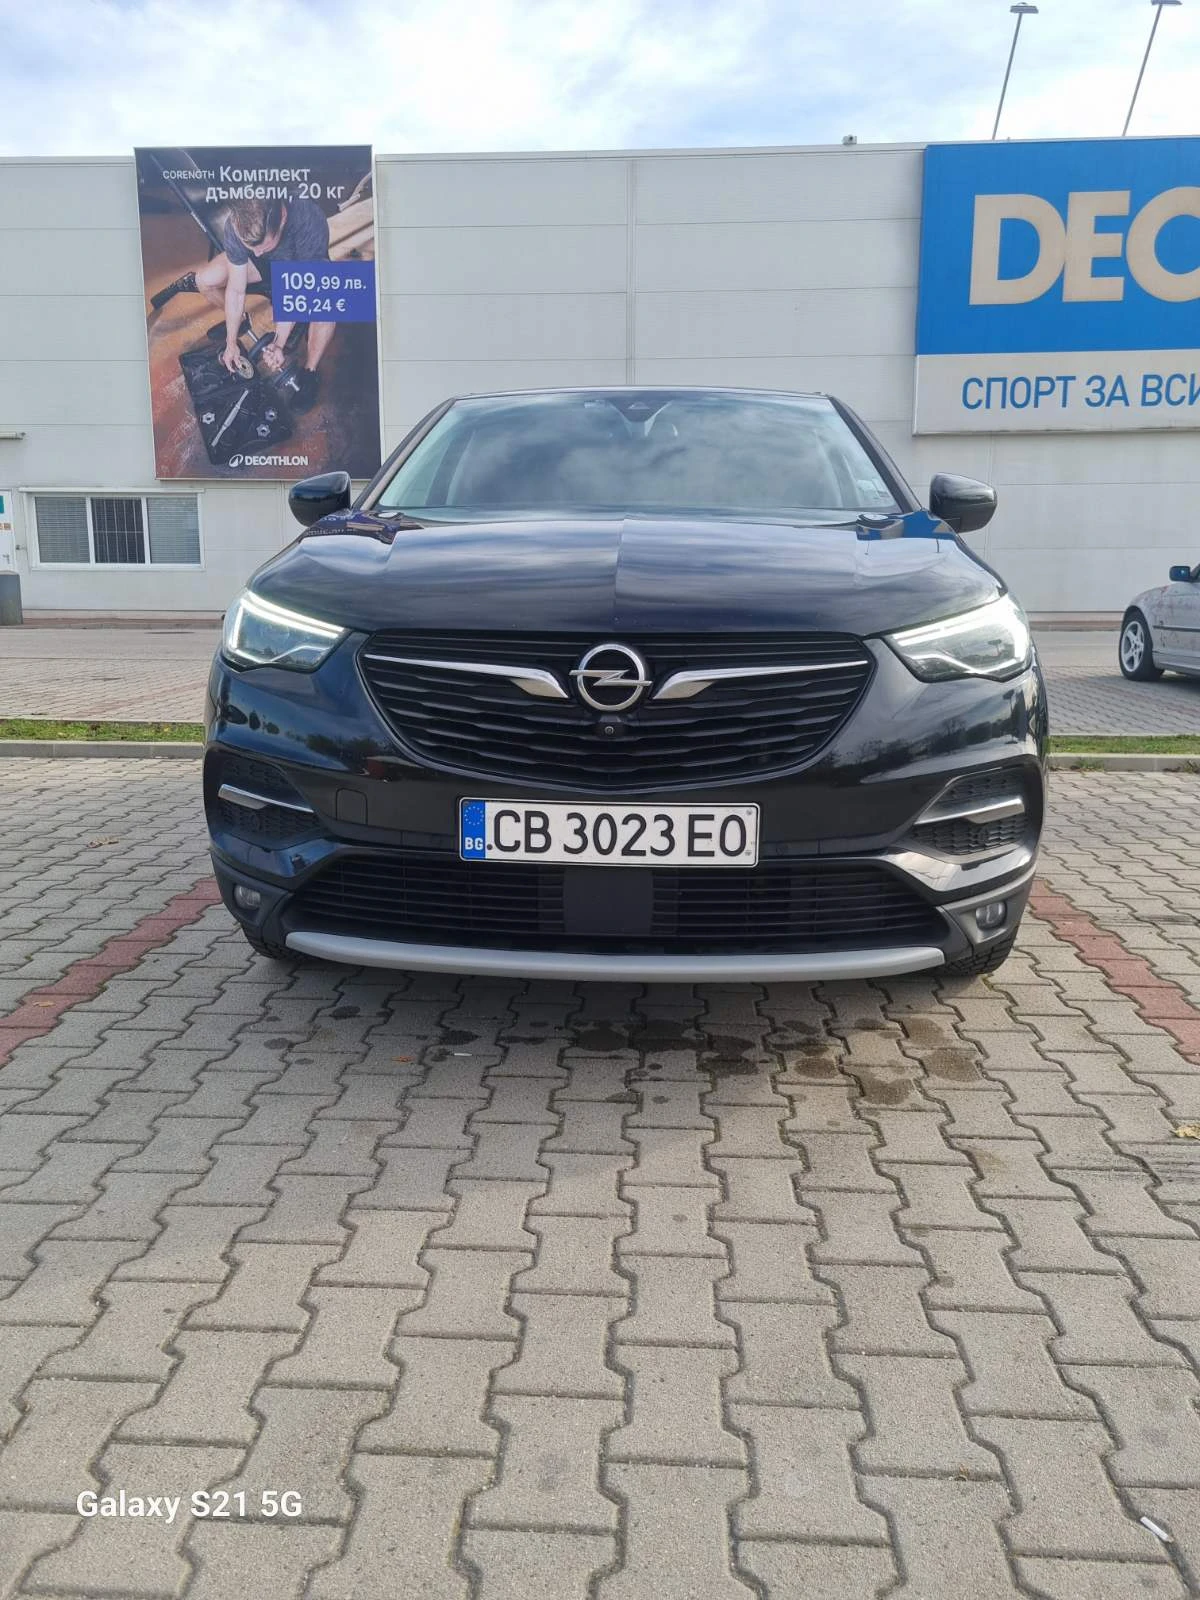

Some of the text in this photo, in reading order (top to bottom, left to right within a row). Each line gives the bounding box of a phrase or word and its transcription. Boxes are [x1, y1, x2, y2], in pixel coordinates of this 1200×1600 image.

[219, 166, 310, 182] Комплект
[206, 183, 345, 202] дъмбели, 20 кг
[969, 186, 1200, 305] DEC
[281, 272, 367, 292] 109,99 лв.
[282, 295, 346, 314] 56,24 €
[962, 376, 1076, 409] СПОРТ
[1084, 374, 1130, 408] ЗА
[245, 456, 308, 466] DECATHLON
[493, 809, 551, 854] CB
[563, 811, 676, 857] 3023
[464, 837, 484, 850] BG
